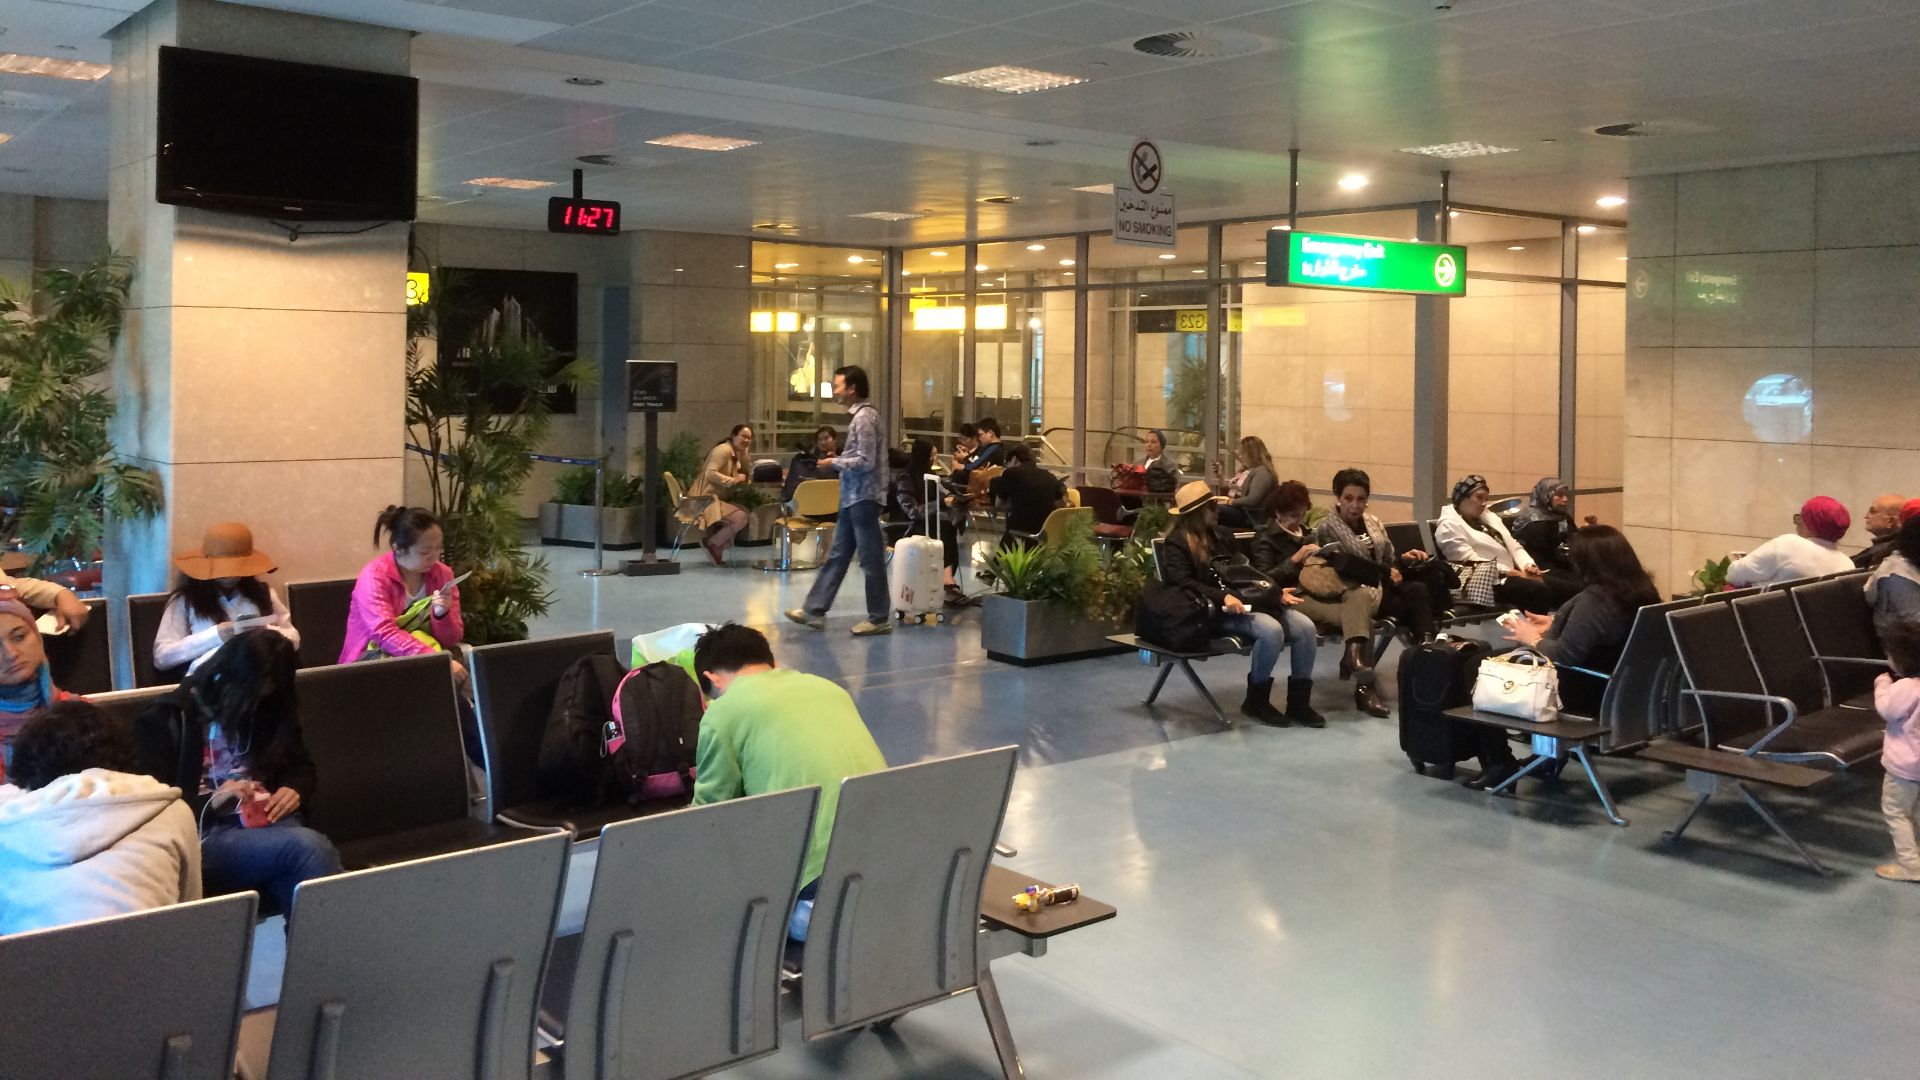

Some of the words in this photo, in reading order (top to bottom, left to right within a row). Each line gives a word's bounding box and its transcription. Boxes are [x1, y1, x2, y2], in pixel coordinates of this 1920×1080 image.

[564, 205, 614, 228] 11:27
[1119, 220, 1131, 233] NO
[1133, 221, 1172, 237] SMOKING
